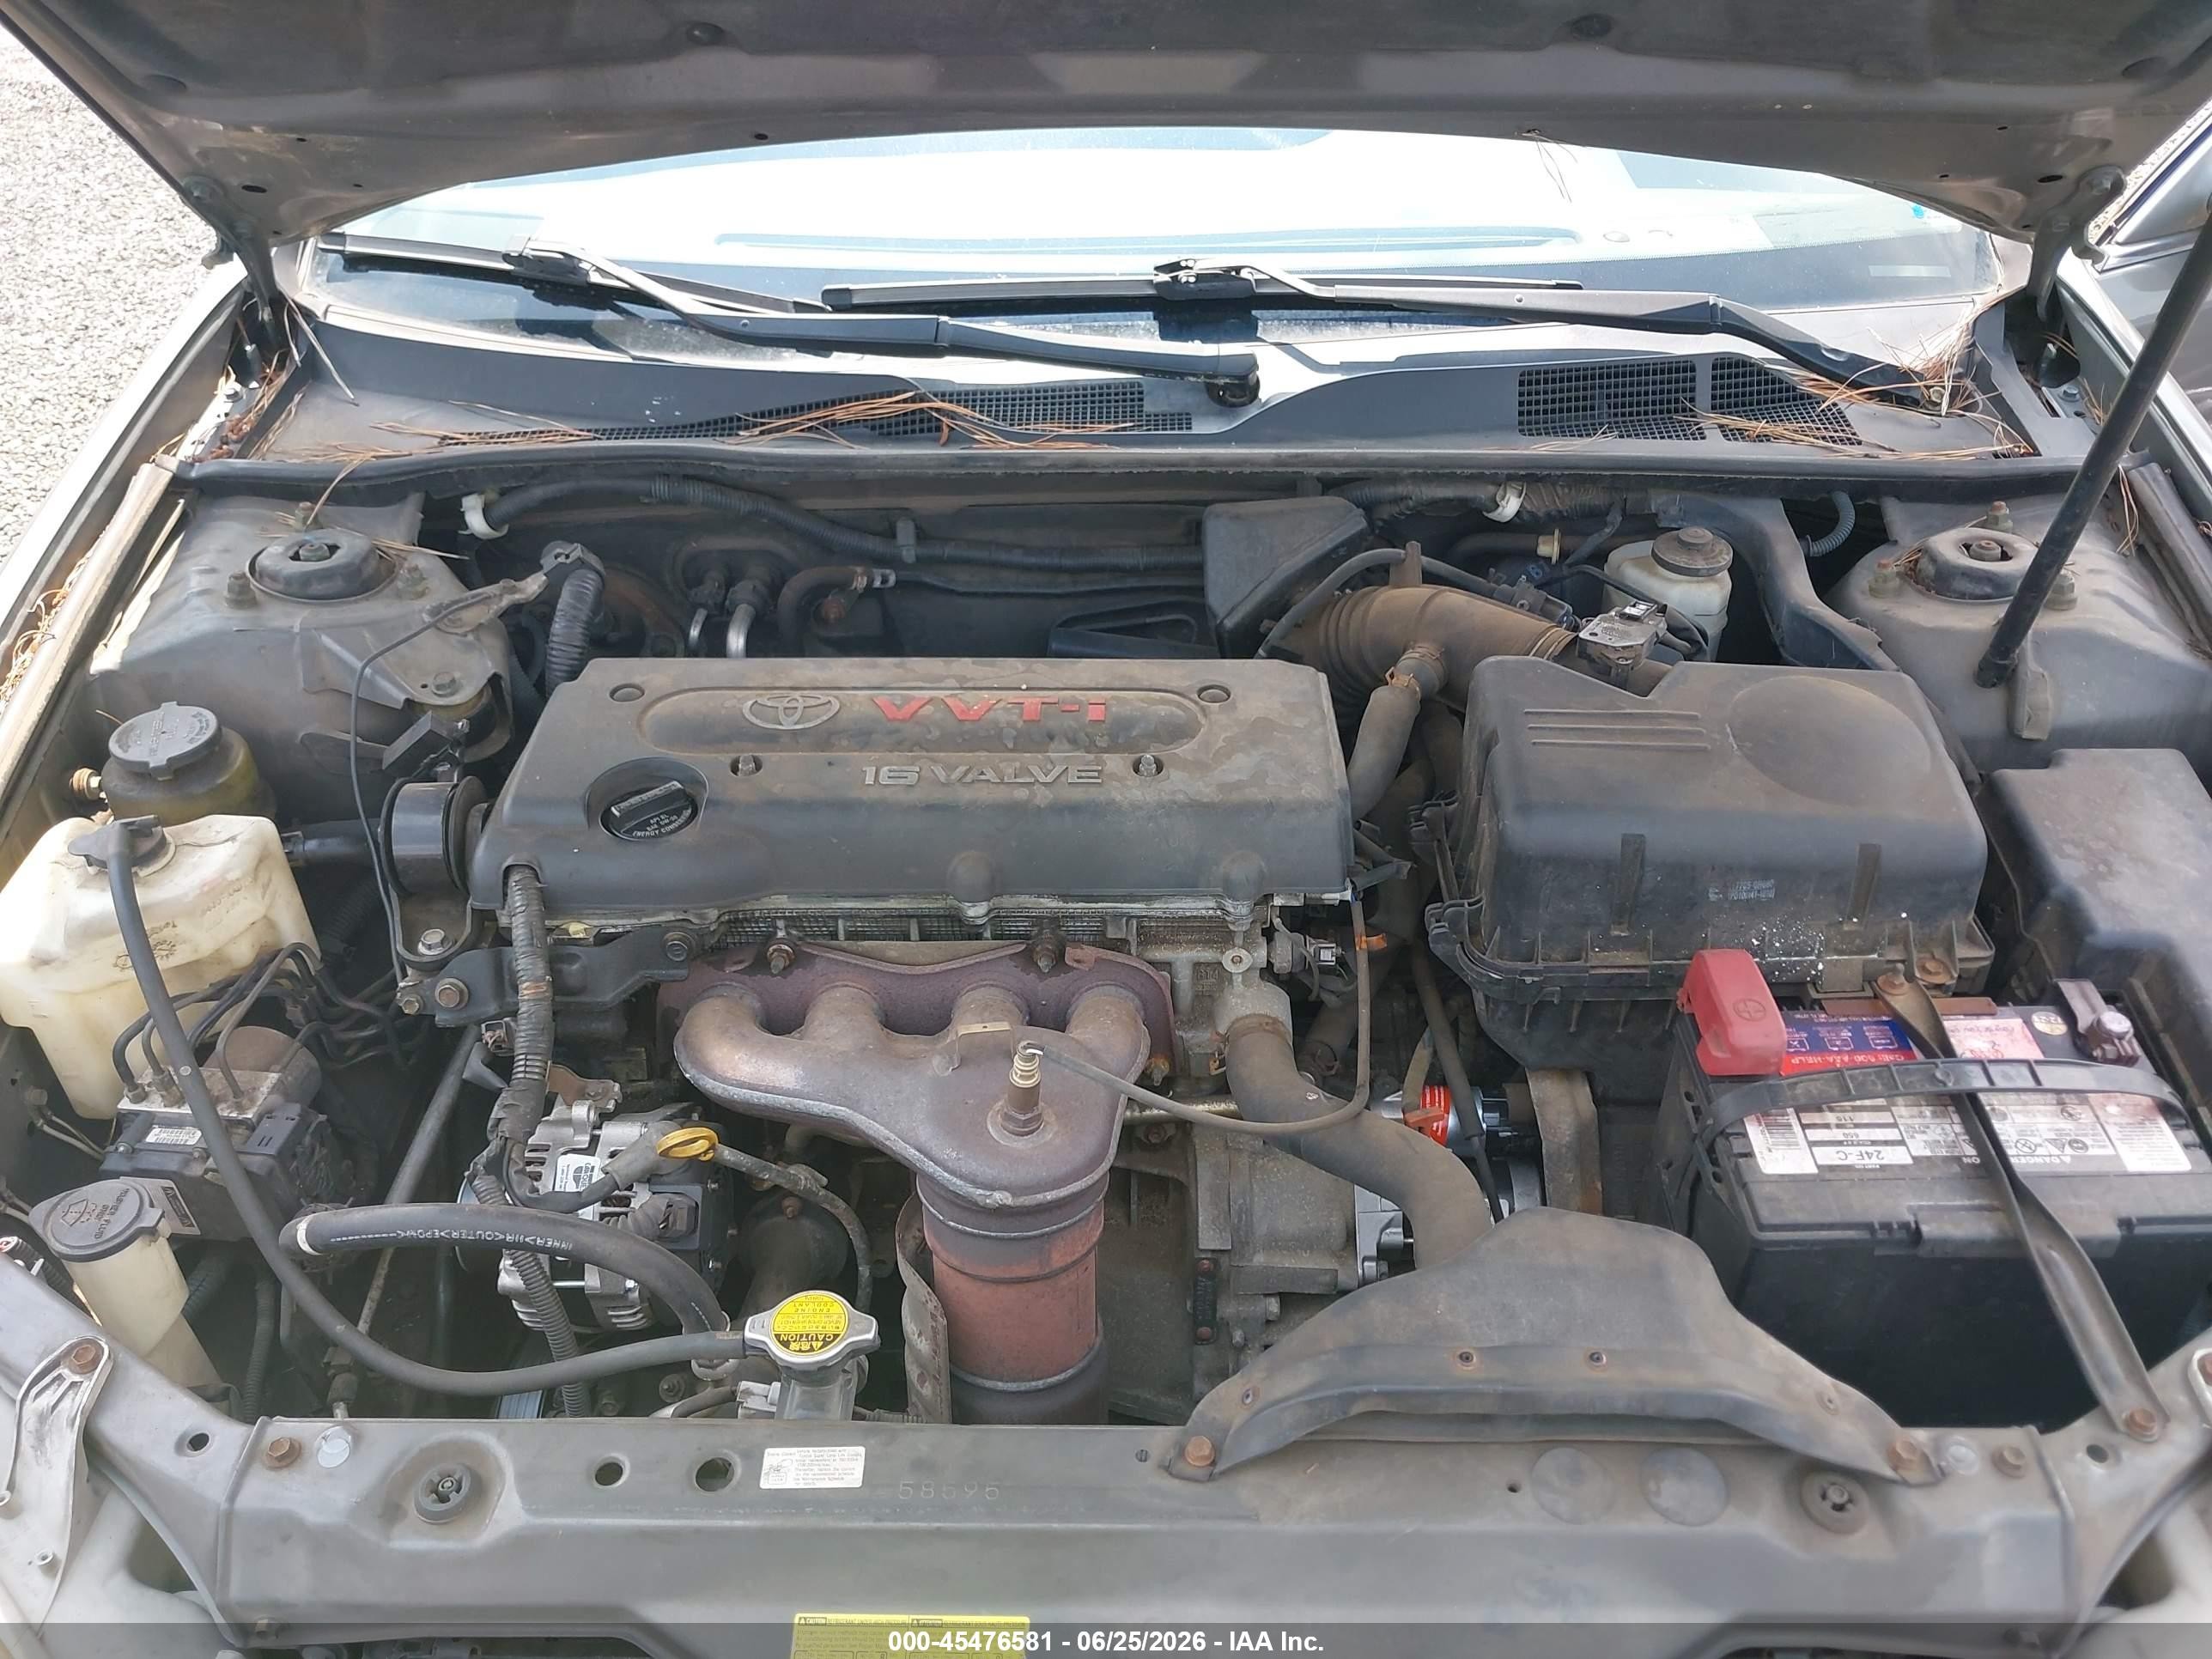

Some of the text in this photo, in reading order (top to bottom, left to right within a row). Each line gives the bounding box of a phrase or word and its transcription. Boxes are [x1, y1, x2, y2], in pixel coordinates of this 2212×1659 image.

[862, 765, 1103, 785] 16 VALVE
[1835, 1149, 1885, 1161] 24F-C
[898, 1480, 1000, 1499] 58595
